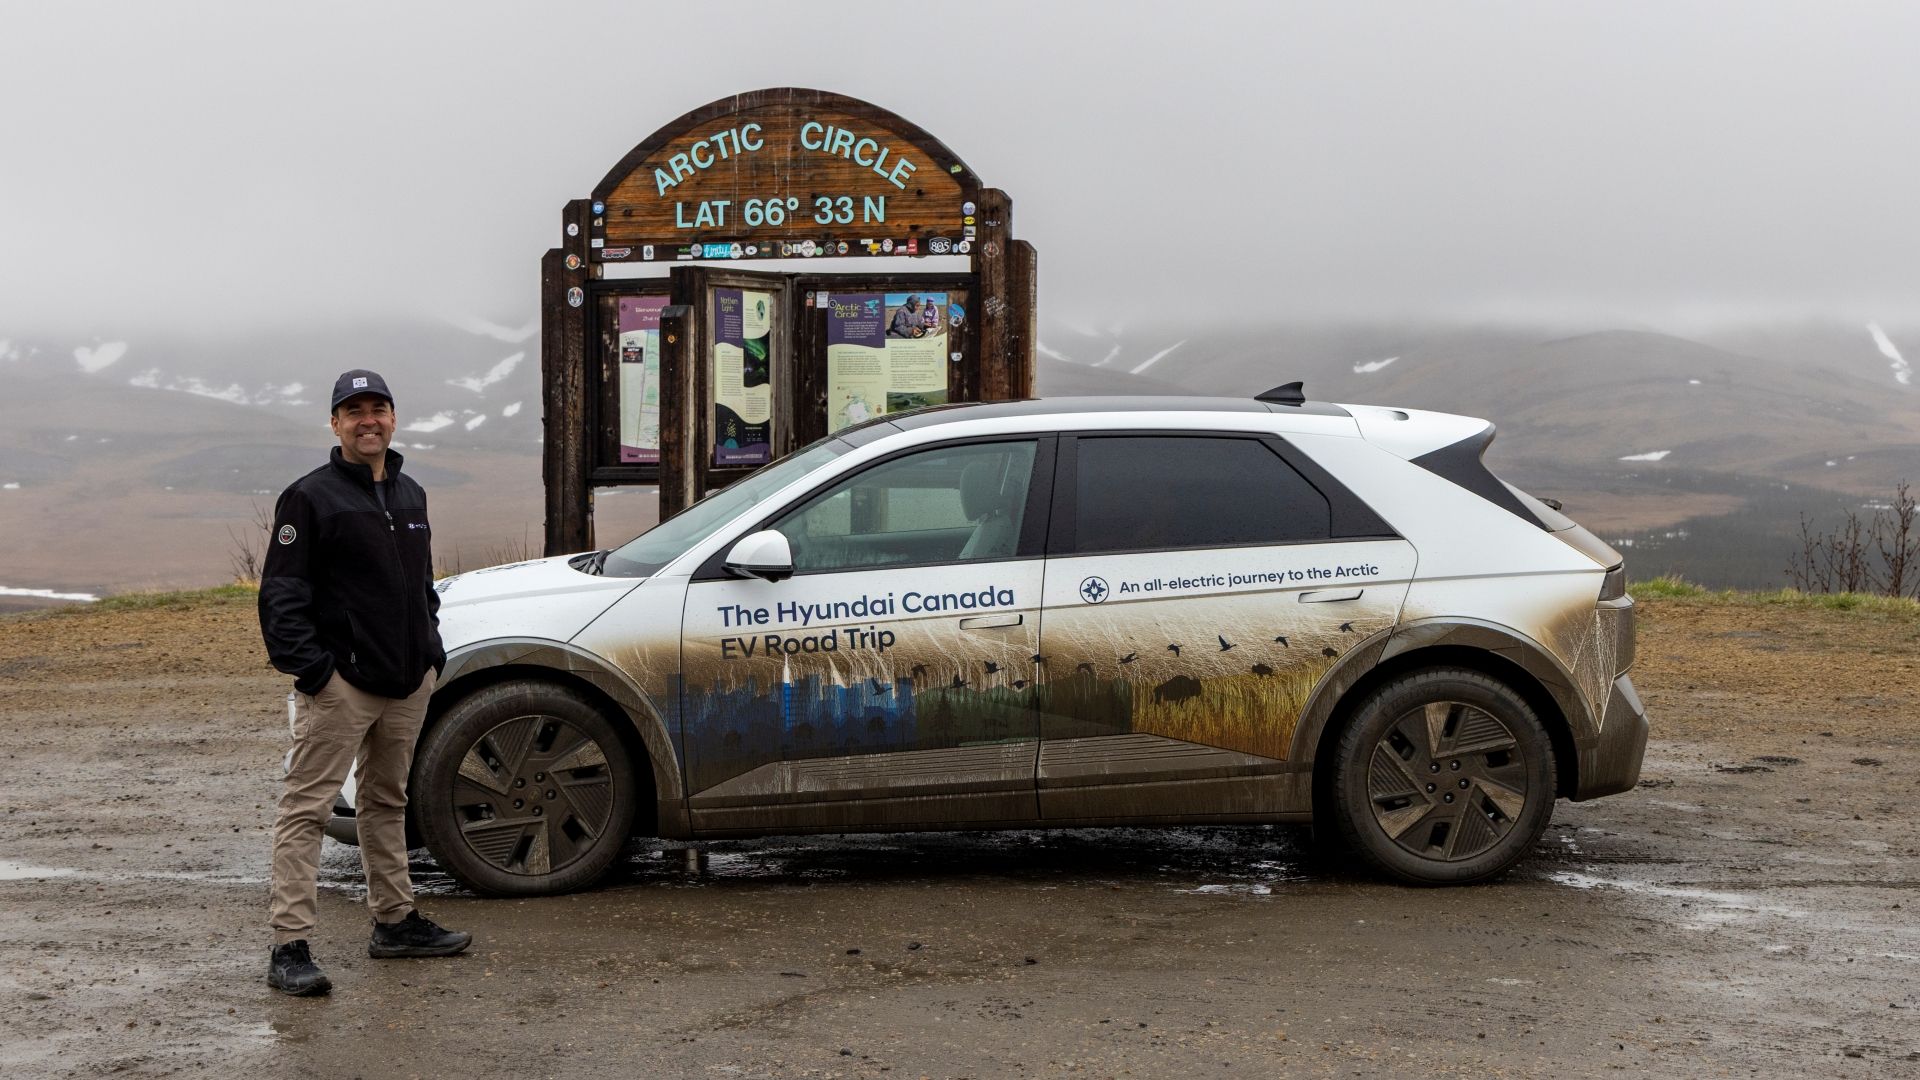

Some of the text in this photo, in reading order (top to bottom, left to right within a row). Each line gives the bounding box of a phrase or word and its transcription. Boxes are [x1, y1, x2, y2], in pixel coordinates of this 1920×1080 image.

[654, 121, 917, 197] ARCTIC CIRCLE
[676, 195, 885, 229] LAT 66° 33 N
[930, 241, 950, 254] 805
[834, 311, 859, 319] Circle
[835, 303, 862, 311] Arctic
[1119, 564, 1379, 594] An all-electric journey to the Arctic
[717, 585, 1015, 628] The Hyundai Canada
[720, 625, 896, 660] EV Road Trip
